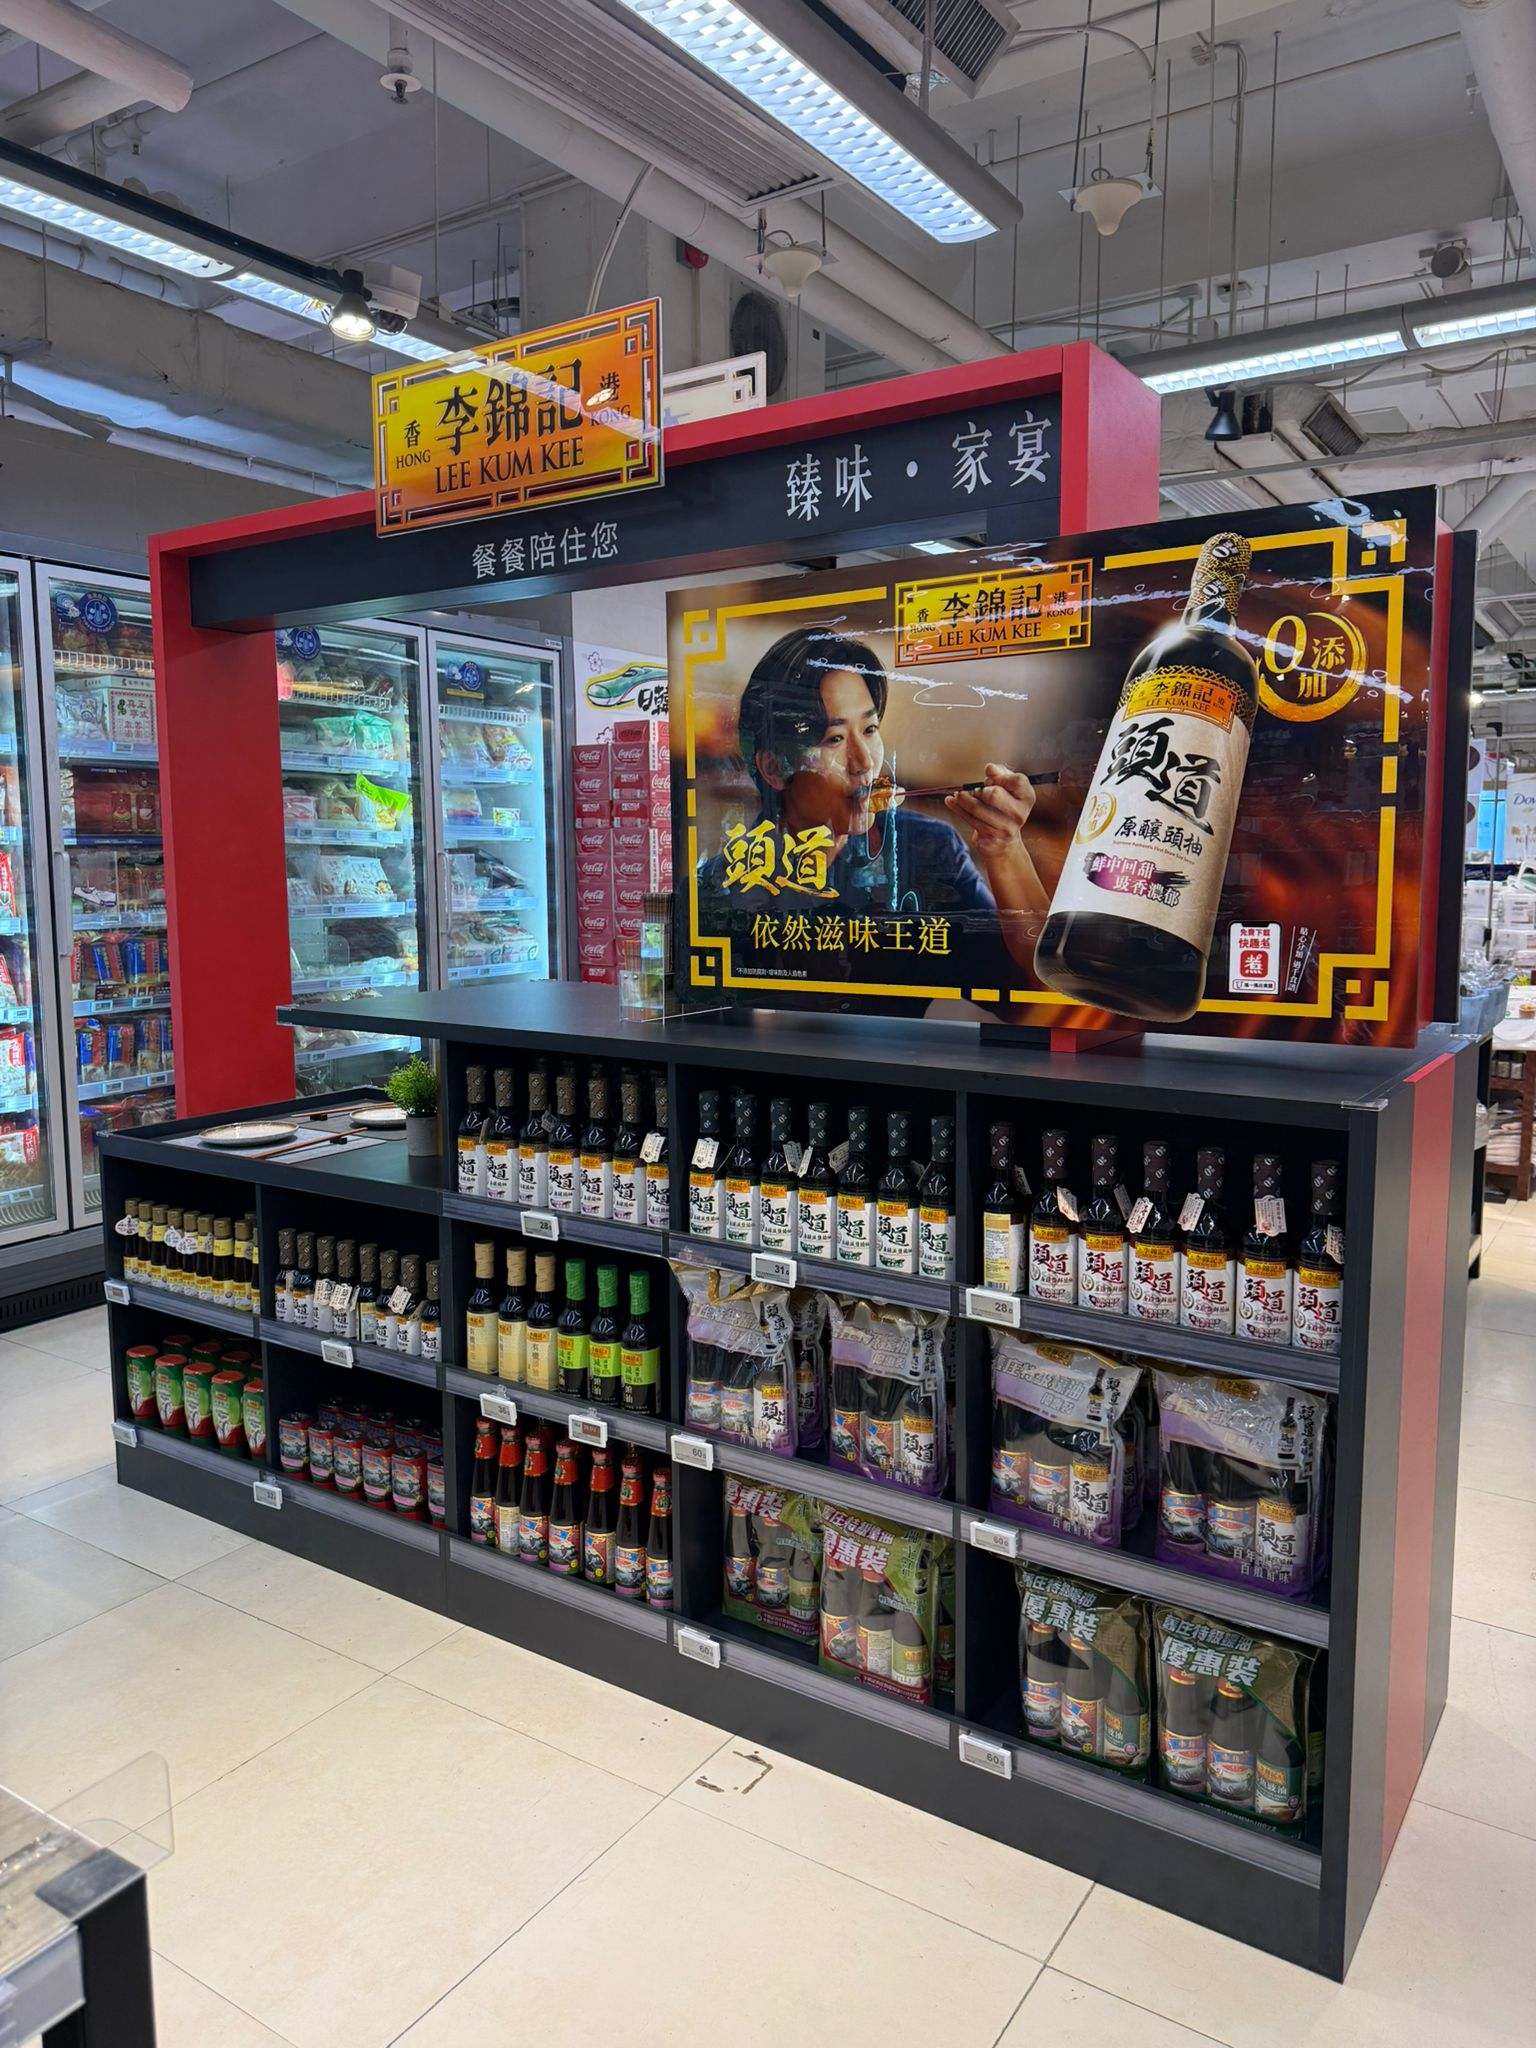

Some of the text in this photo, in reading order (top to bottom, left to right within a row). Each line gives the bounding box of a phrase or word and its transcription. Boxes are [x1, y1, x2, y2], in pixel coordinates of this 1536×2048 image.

[434, 358, 583, 457] 李錦記
[590, 404, 631, 426] KONG
[404, 420, 421, 448] 香
[395, 449, 431, 469] HONG
[434, 438, 584, 493] LEE KUM KEE
[472, 521, 619, 579] 餐餐陪住您
[917, 608, 929, 622] 香
[939, 584, 1041, 628] 李錦記
[1046, 607, 1075, 618] KONG
[909, 624, 936, 634] HONG
[938, 622, 1042, 647] LEE KUM KEE
[1146, 698, 1210, 712] LEE KUM KEE
[1153, 681, 1214, 704] 李錦記
[1100, 717, 1222, 836] 頭道
[722, 819, 840, 899] 頭道
[750, 913, 951, 955] 依然滋味王道
[1033, 1243, 1070, 1276] 頭道
[1085, 1252, 1124, 1284] 頭道
[1135, 1261, 1174, 1295] 頭道
[1186, 1269, 1227, 1304] 頭道
[1243, 1278, 1286, 1314] 頭道
[1298, 1287, 1340, 1325] 頭道
[1073, 1480, 1108, 1513] 頭道
[1259, 1519, 1296, 1557] 頭道
[1022, 1592, 1099, 1643] 優惠裝
[1161, 1636, 1262, 1687] 優惠裝
